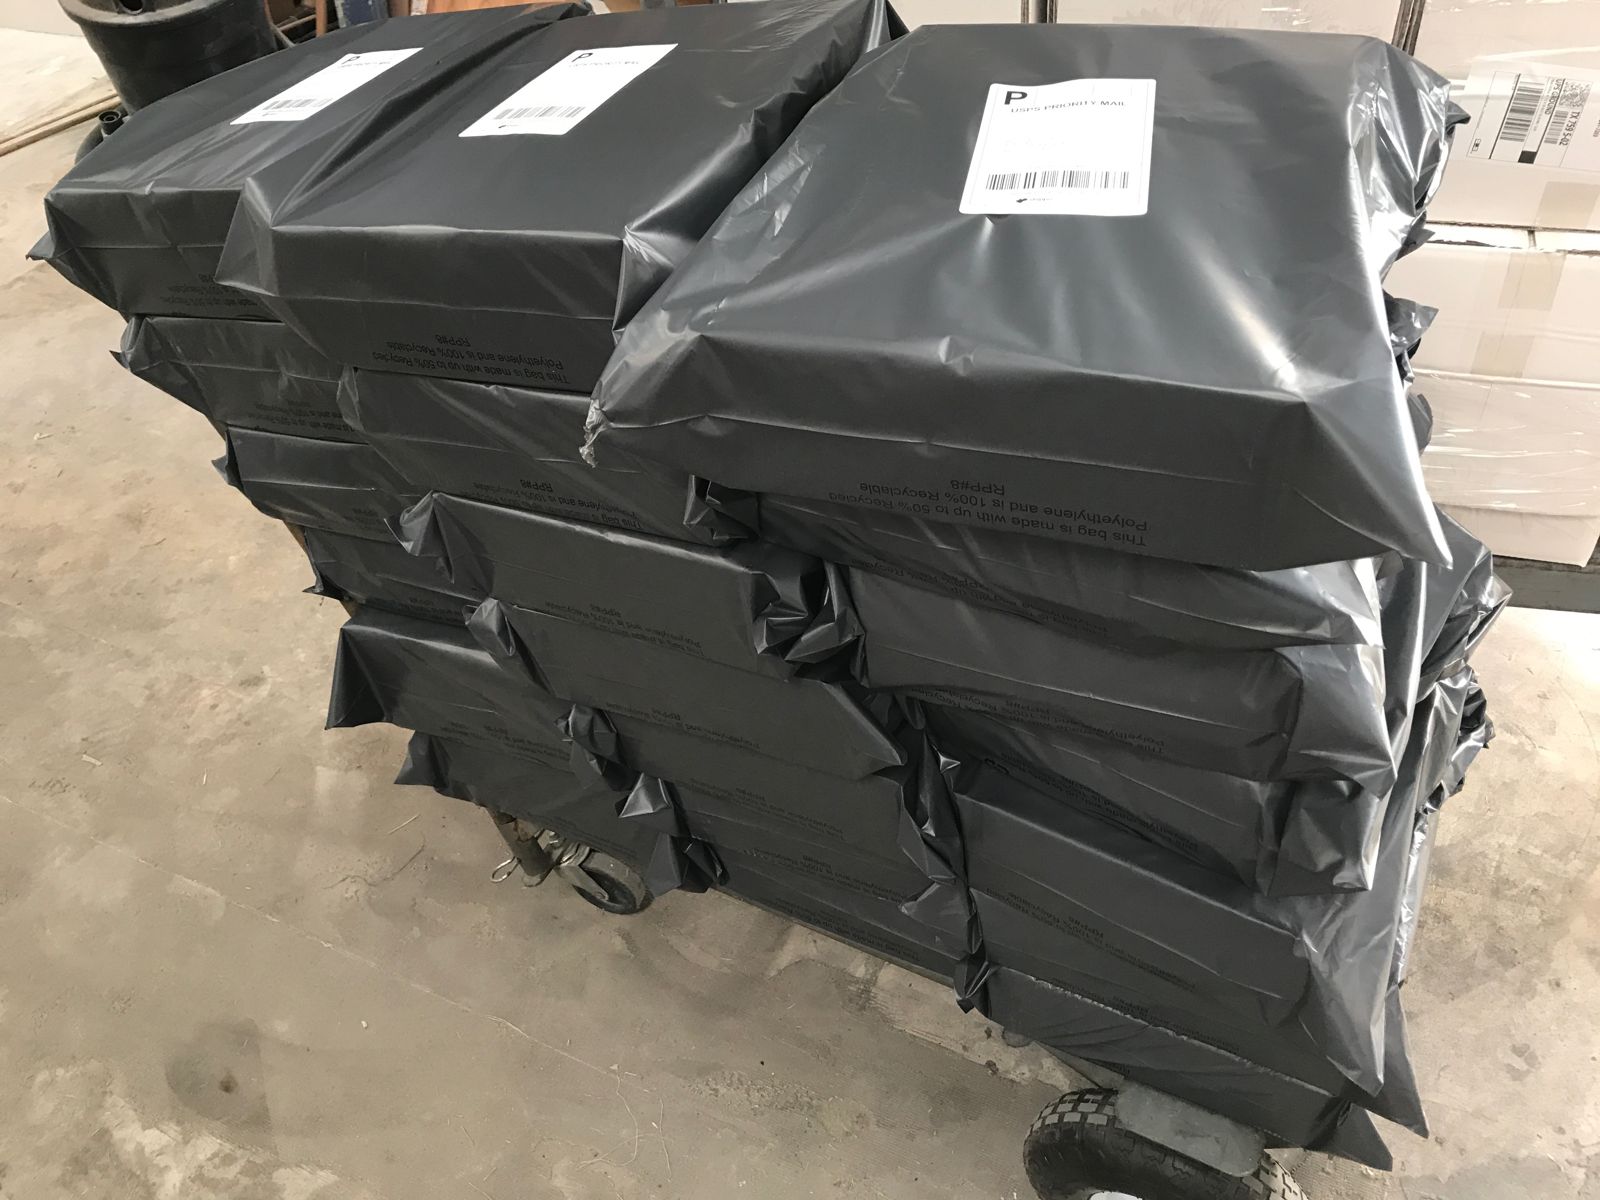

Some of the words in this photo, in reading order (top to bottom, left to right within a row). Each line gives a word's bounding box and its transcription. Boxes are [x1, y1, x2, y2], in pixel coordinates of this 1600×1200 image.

[571, 52, 594, 63] P
[1553, 78, 1563, 90] UPS
[1004, 91, 1028, 105] P
[1044, 100, 1097, 112] PRIORITY
[1100, 100, 1126, 108] MAIL
[1570, 111, 1580, 119] TX
[477, 352, 495, 364] and
[498, 353, 564, 370] Polyethylene
[448, 361, 460, 371] up
[484, 366, 511, 376] made
[524, 368, 544, 380] bag
[546, 374, 569, 384] This
[859, 482, 940, 501] Recyclable
[950, 479, 1005, 496] RPP#8
[558, 496, 577, 506] and
[828, 492, 893, 511] Recycled
[944, 491, 986, 508] 100%
[991, 499, 1005, 512] is
[898, 501, 930, 514] 50%
[935, 505, 949, 516] to
[951, 505, 971, 519] up
[1009, 501, 1038, 515] and
[976, 511, 1007, 526] with
[1011, 517, 1055, 532] made
[1043, 506, 1149, 532] Polyethylene
[1059, 524, 1073, 536] is
[1078, 523, 1108, 541] bag
[1111, 531, 1147, 547] This
